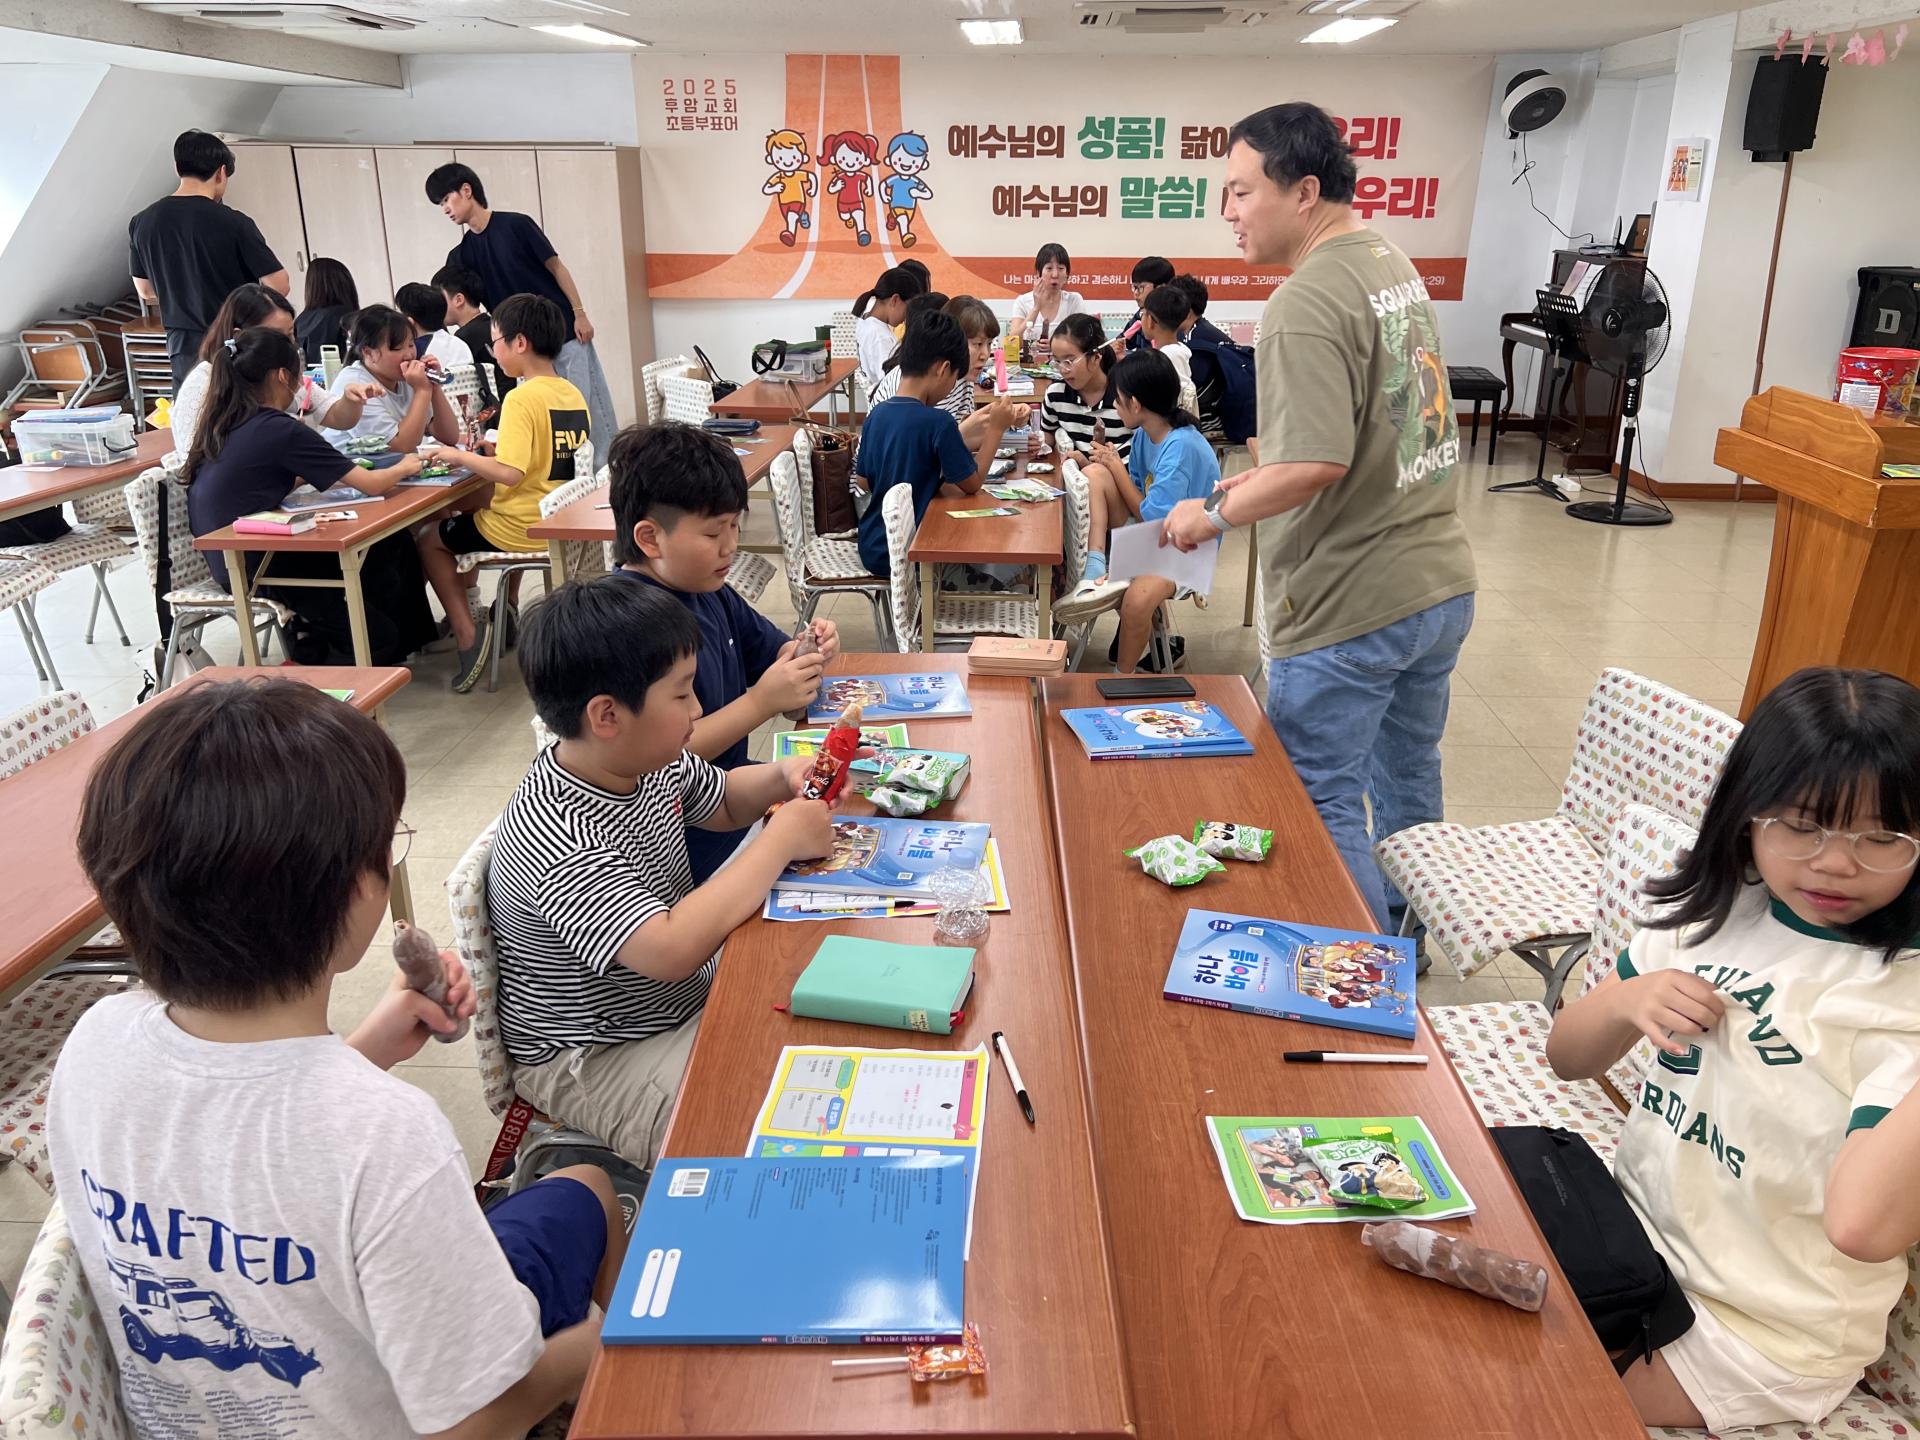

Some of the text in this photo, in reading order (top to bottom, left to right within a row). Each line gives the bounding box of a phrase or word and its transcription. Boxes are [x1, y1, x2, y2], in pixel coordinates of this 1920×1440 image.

[663, 79, 736, 95] 2025
[665, 98, 737, 114] 후암교회
[666, 116, 738, 131] 초등부표어
[948, 124, 1065, 158] 예수님의
[1077, 116, 1166, 159] 성품!
[1332, 116, 1401, 159] 리!
[992, 184, 1108, 218] 예수님의
[1120, 176, 1207, 219] 말씀!
[1352, 176, 1439, 219] 우리!
[1003, 275, 1022, 286] 나는
[1091, 275, 1128, 286] 겸손하니
[1220, 275, 1248, 286] 배우라
[1396, 438, 1460, 494] MONKEY
[1193, 955, 1223, 984] 하나
[1223, 949, 1259, 990] 바이블
[81, 1169, 316, 1285] CRAFTED
